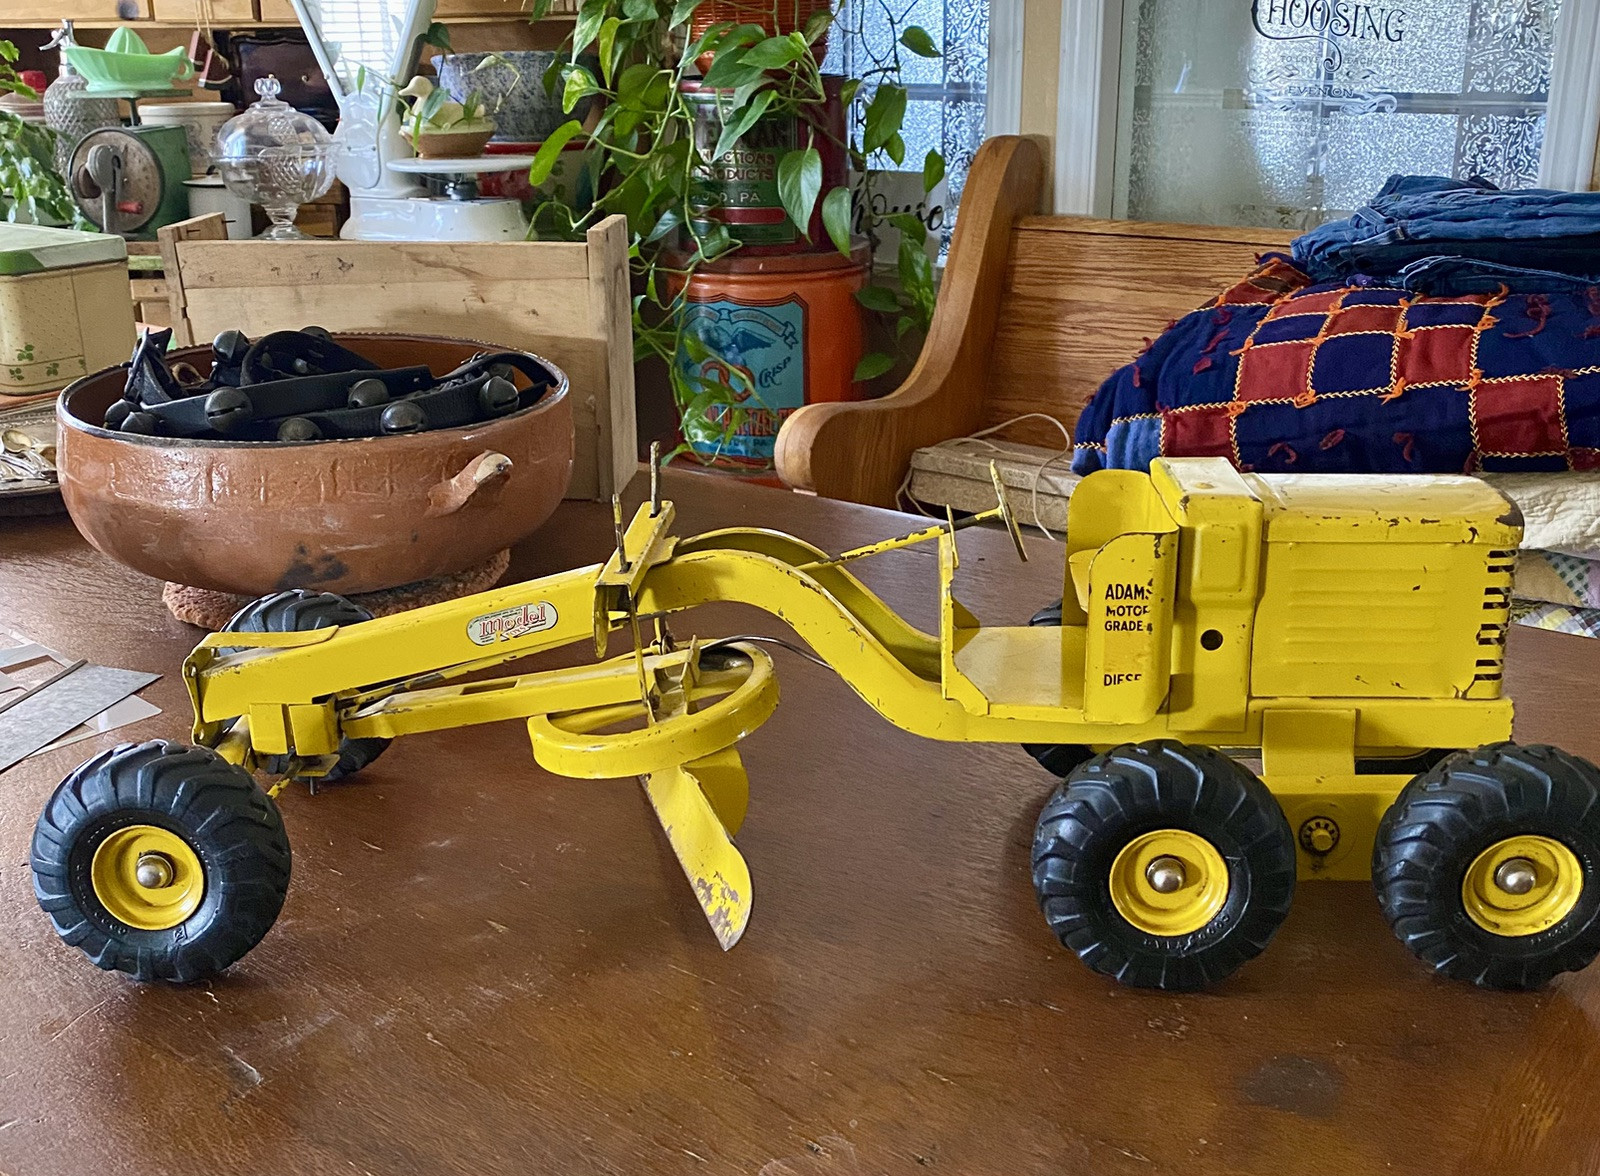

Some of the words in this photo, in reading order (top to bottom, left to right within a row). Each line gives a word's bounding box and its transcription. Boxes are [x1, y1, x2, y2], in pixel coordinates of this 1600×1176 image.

[1251, 0, 1406, 69] CHOOSING
[1287, 86, 1328, 97] EVEN
[1332, 88, 1354, 98] ON
